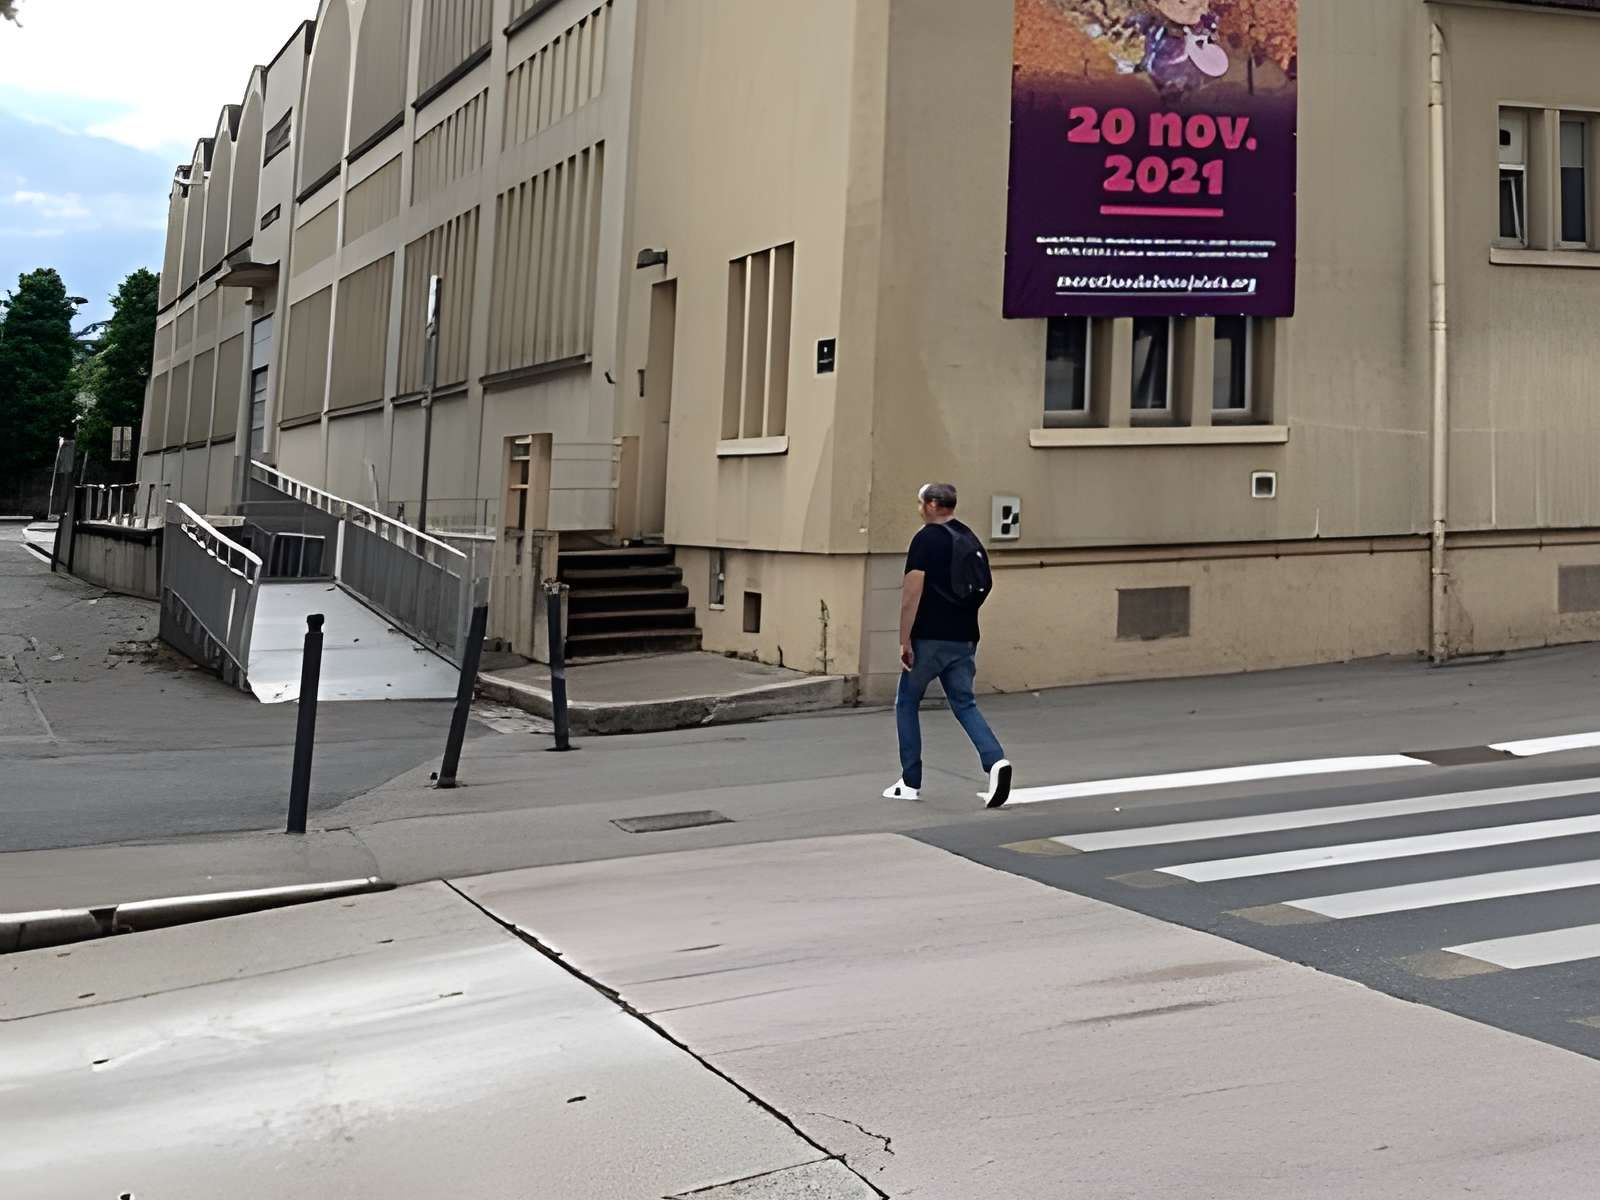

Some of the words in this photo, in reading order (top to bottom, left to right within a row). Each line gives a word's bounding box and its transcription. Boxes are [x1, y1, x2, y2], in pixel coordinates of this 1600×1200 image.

[1067, 106, 1136, 145] 20
[1149, 111, 1257, 151] nov.
[1103, 154, 1224, 195] 2021
